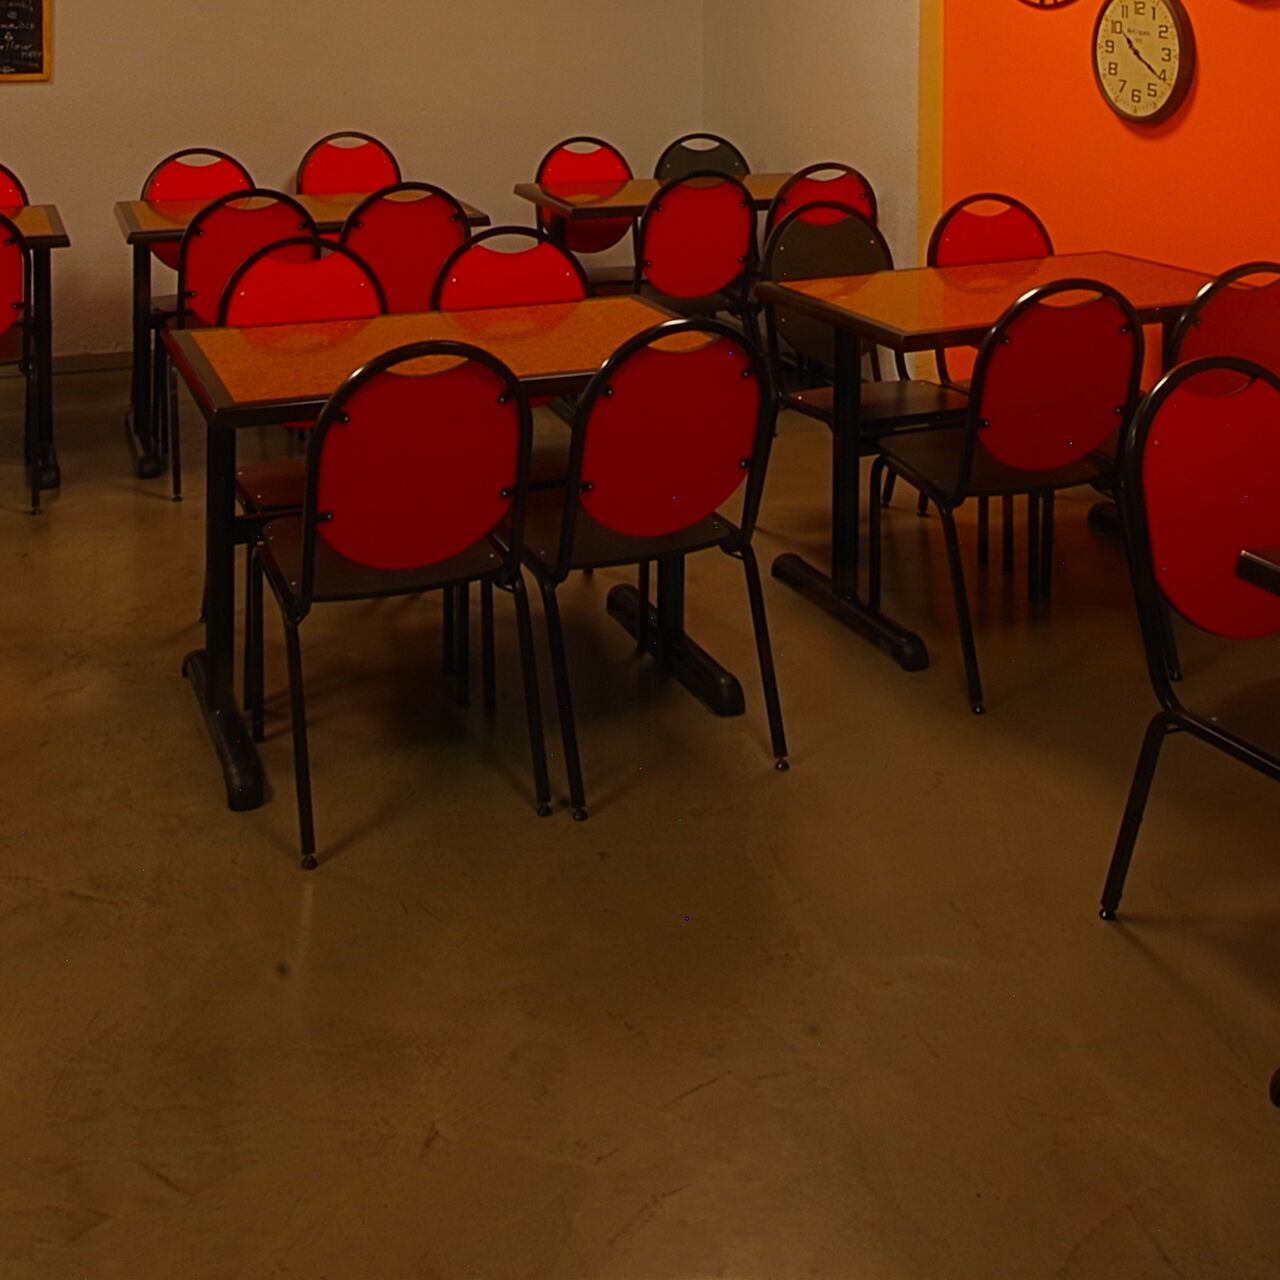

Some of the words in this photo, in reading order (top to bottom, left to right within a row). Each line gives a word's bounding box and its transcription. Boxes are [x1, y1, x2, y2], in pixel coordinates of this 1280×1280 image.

[1122, 5, 1128, 18] 11
[1134, 2, 1145, 15] 12
[1151, 7, 1156, 20] 1
[1111, 20, 1122, 34] 10
[1159, 25, 1168, 39] 2
[1105, 40, 1114, 54] 9
[1161, 48, 1171, 62] 3
[1108, 63, 1117, 76] 8
[1158, 70, 1167, 82] 4
[1119, 80, 1126, 92] 7
[1147, 83, 1157, 97] 5
[1132, 89, 1141, 103] 6
